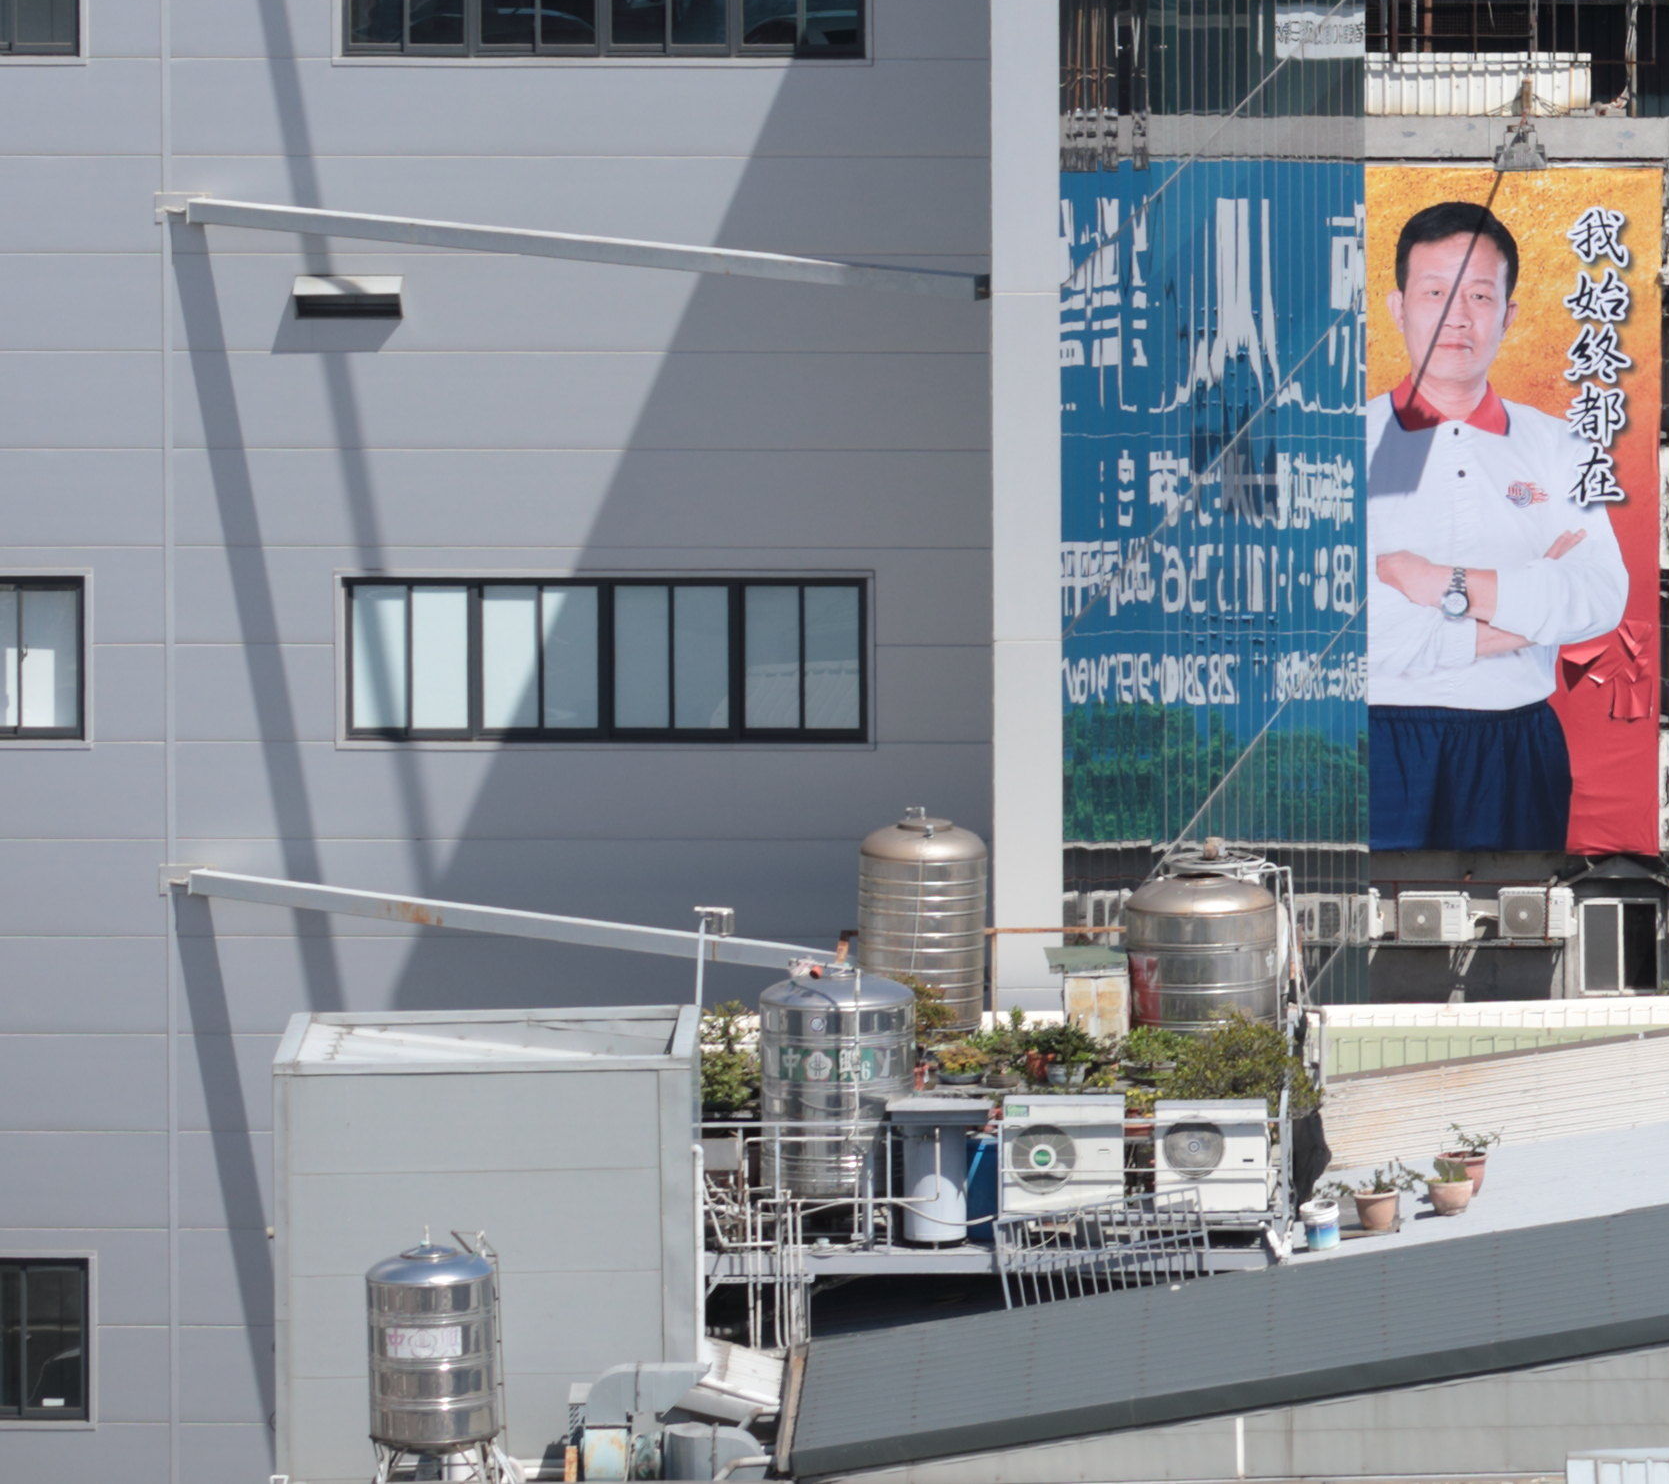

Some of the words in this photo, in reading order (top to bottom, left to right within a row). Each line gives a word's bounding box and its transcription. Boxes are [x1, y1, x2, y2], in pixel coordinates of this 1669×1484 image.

[1566, 208, 1629, 508] 我始終都在
